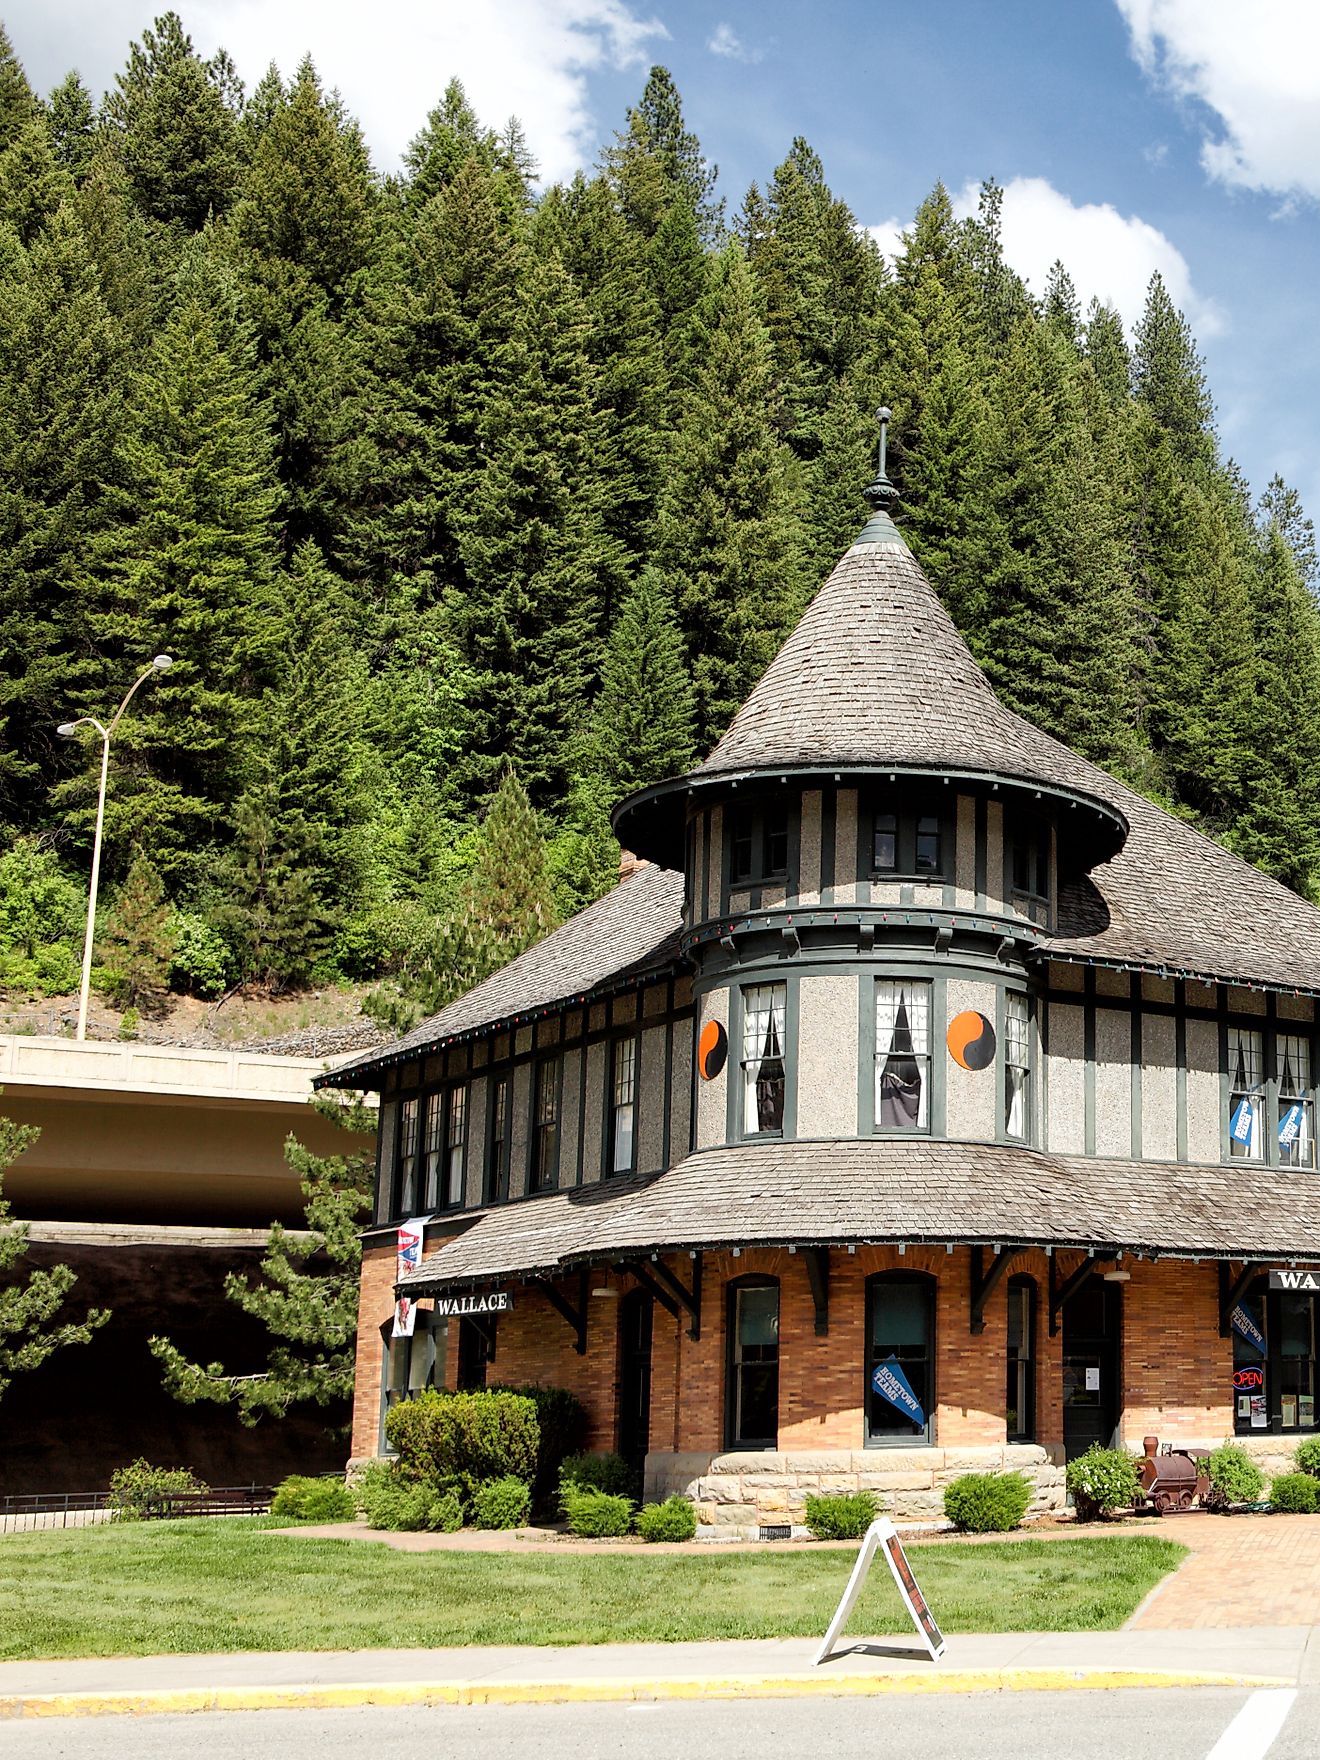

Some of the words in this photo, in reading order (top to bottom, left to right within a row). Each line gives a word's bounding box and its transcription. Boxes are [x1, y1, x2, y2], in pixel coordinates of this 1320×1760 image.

[438, 1292, 508, 1316] WALLACE
[1231, 1310, 1249, 1335] TEAMS
[1234, 1305, 1263, 1343] HOMETOWN
[873, 1371, 899, 1401] TEAMS
[880, 1366, 919, 1411] HOMETOWN
[1232, 1372, 1263, 1385] OPEN
